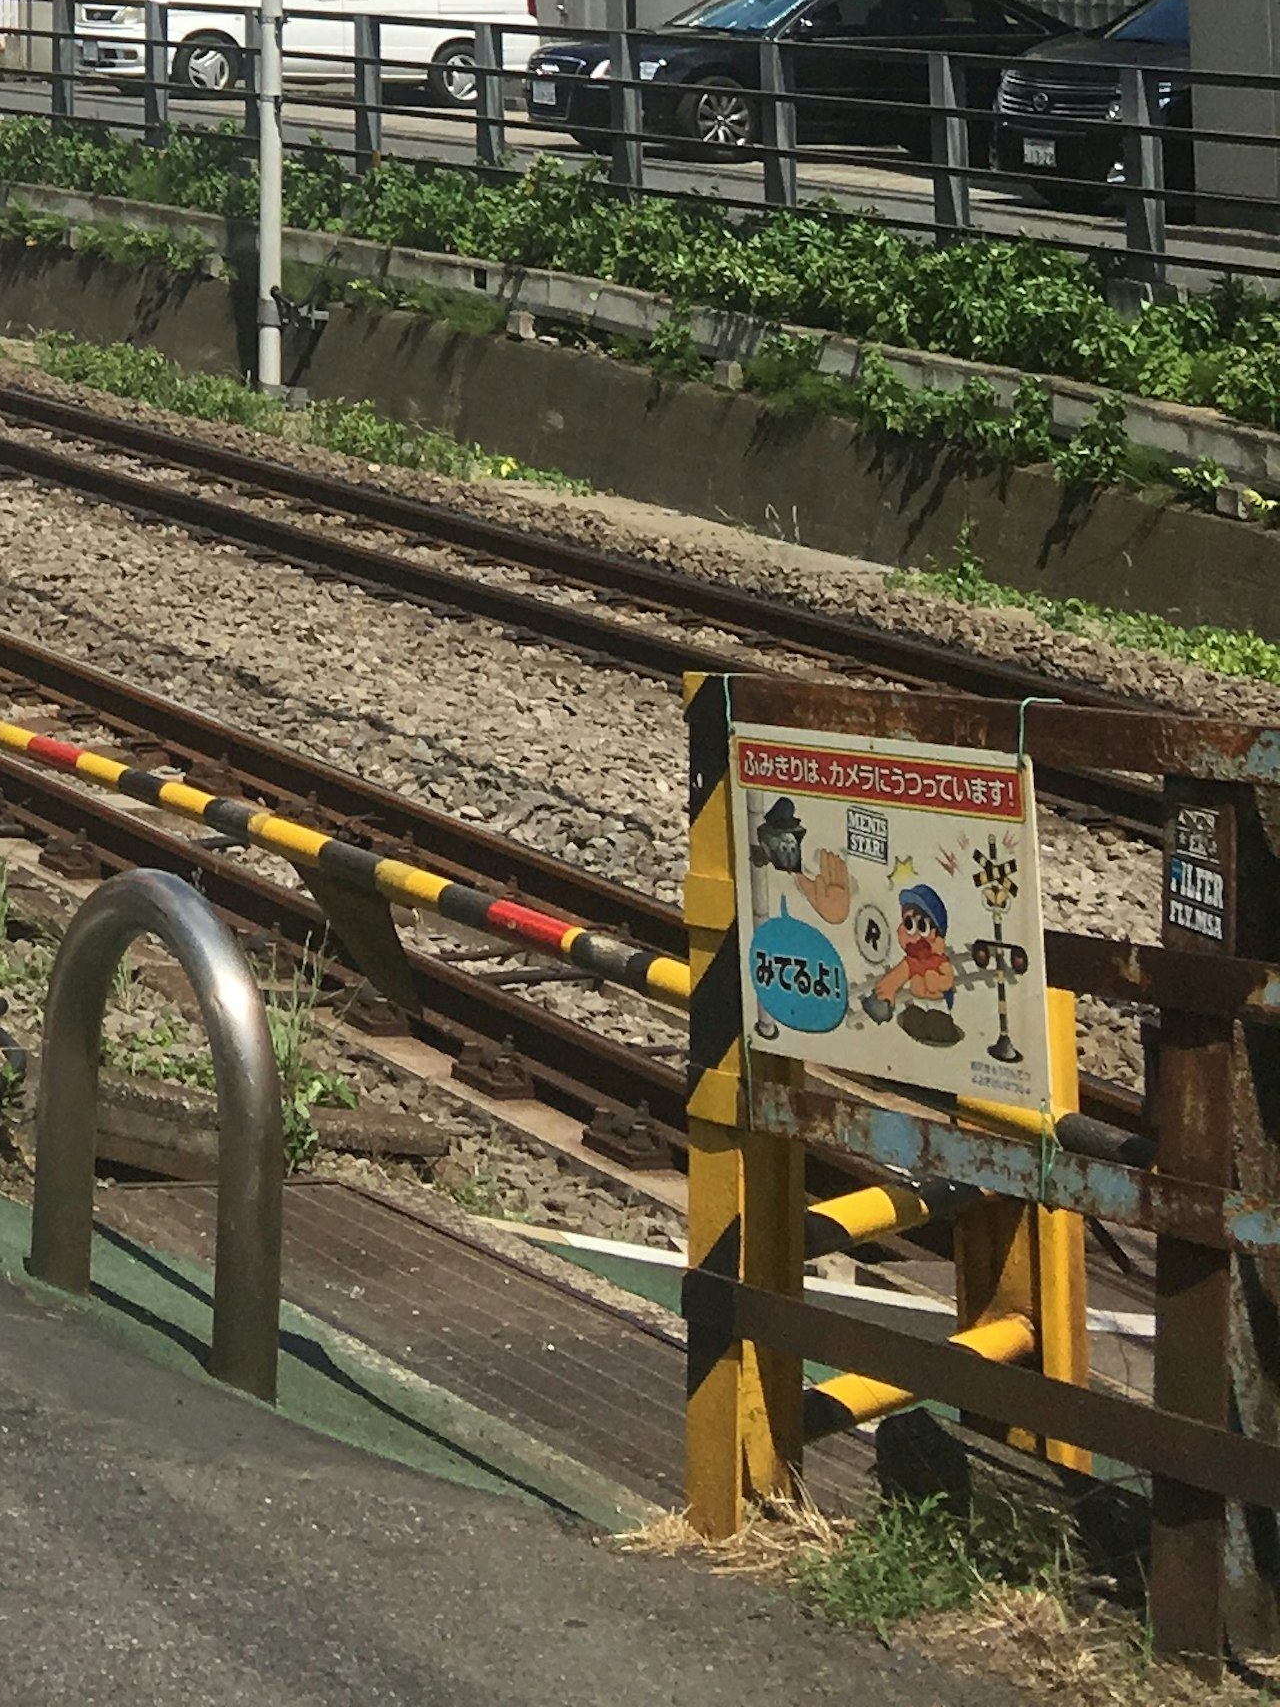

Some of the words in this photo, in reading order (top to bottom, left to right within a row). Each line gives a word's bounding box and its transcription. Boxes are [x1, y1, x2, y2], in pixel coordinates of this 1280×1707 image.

[744, 750, 1014, 807] ふみきりは、カメラにうつっています!
[864, 918, 881, 951] R
[755, 951, 840, 999] みてるよ!
